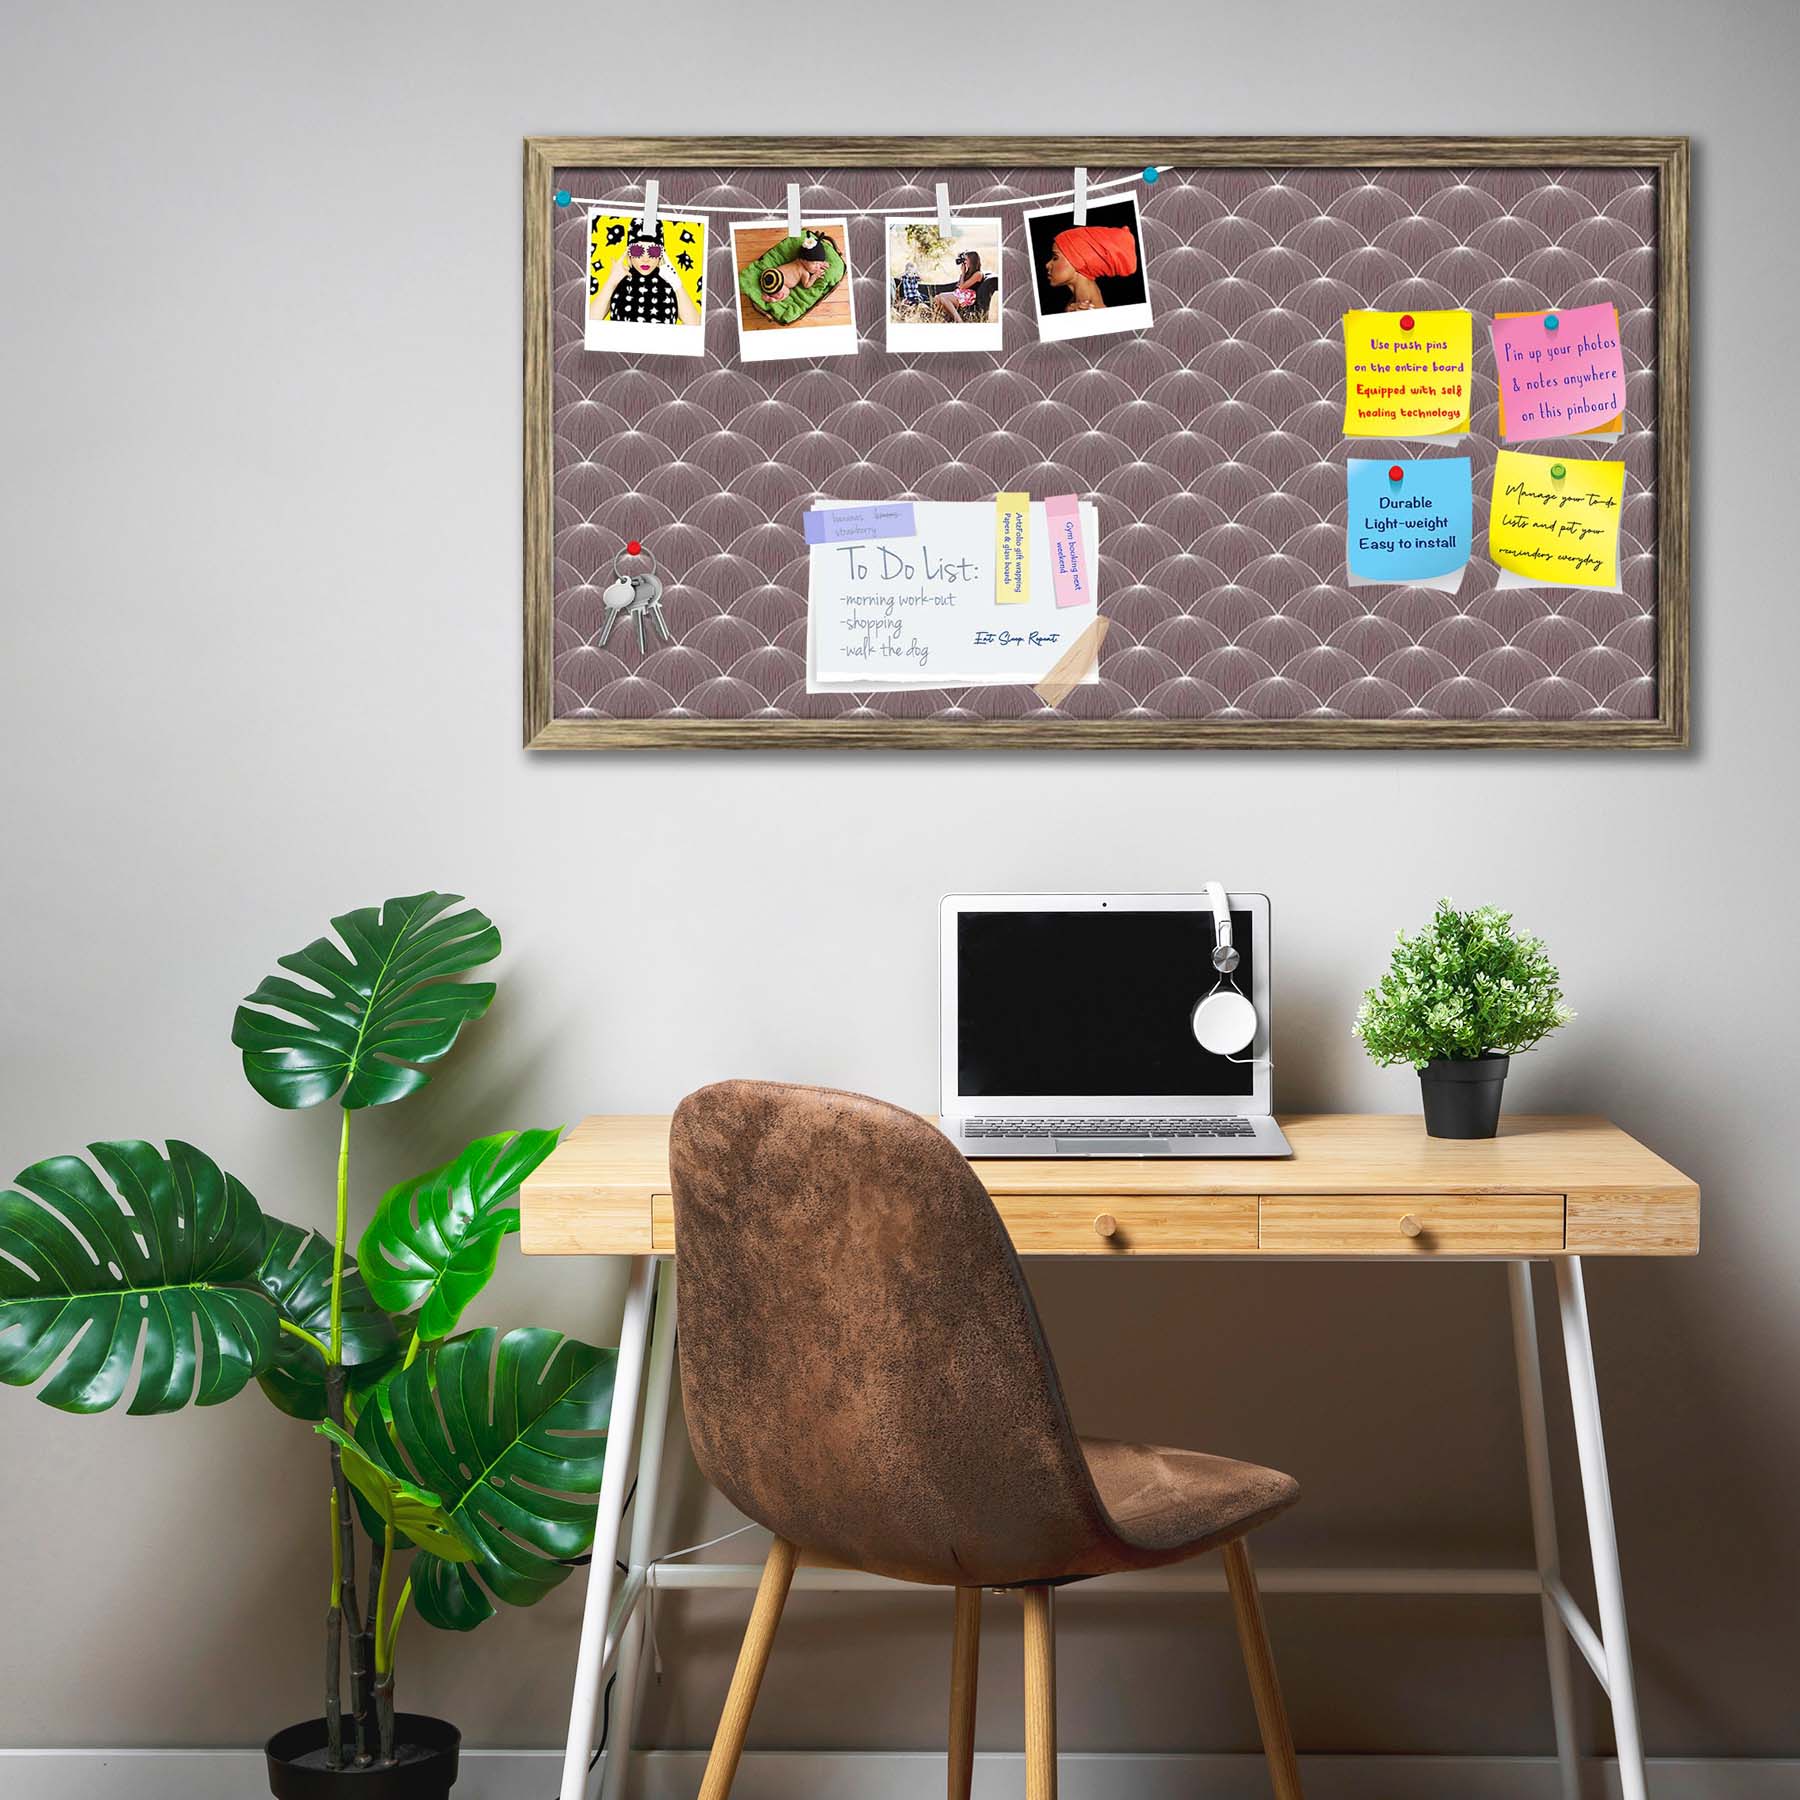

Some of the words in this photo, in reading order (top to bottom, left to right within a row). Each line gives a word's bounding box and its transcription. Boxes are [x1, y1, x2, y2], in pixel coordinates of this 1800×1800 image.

[1371, 339, 1389, 350] Use
[1394, 341, 1422, 353] push
[1426, 341, 1447, 353] pins
[1505, 343, 1523, 361] Pin
[1529, 350, 1542, 363] up
[1547, 345, 1571, 361] your
[1577, 334, 1616, 357] photos
[1354, 364, 1366, 372] on
[1371, 363, 1390, 372] the
[1395, 363, 1428, 372] entire
[1432, 361, 1464, 372] board
[1513, 378, 1520, 392] &
[1527, 372, 1558, 390] notes
[1564, 365, 1617, 388] anywhere
[1356, 384, 1406, 398] Equipped
[1410, 386, 1436, 396] with
[1441, 385, 1462, 397] self
[1358, 408, 1396, 420] healing
[1400, 408, 1460, 420] technology
[1522, 412, 1534, 421] on
[1540, 402, 1562, 419] this
[1567, 393, 1617, 420] pinboard
[1379, 496, 1432, 509] Durable
[1505, 482, 1557, 505] Manage
[1559, 495, 1584, 508] your
[1003, 513, 1012, 535] Papers
[1064, 520, 1074, 540] Gym
[1365, 516, 1448, 532] Light-weight
[1533, 520, 1557, 532] and
[1558, 522, 1582, 537] put
[1579, 526, 1605, 540] your
[1002, 544, 1012, 561] glass
[1359, 537, 1394, 552] Easy
[1398, 539, 1412, 549] to
[1415, 536, 1456, 548] install
[836, 545, 868, 580] To
[877, 546, 915, 580] Do
[922, 545, 979, 583] List:
[1014, 548, 1024, 561] gift
[1056, 541, 1069, 574] weekend
[1068, 541, 1079, 573] booking
[1557, 554, 1603, 572] everyday
[1004, 562, 1012, 585] boards
[1013, 562, 1022, 592] wrapping
[1072, 574, 1082, 591] next
[899, 585, 958, 607] work-out
[880, 635, 902, 657] the
[905, 637, 929, 667] dog
